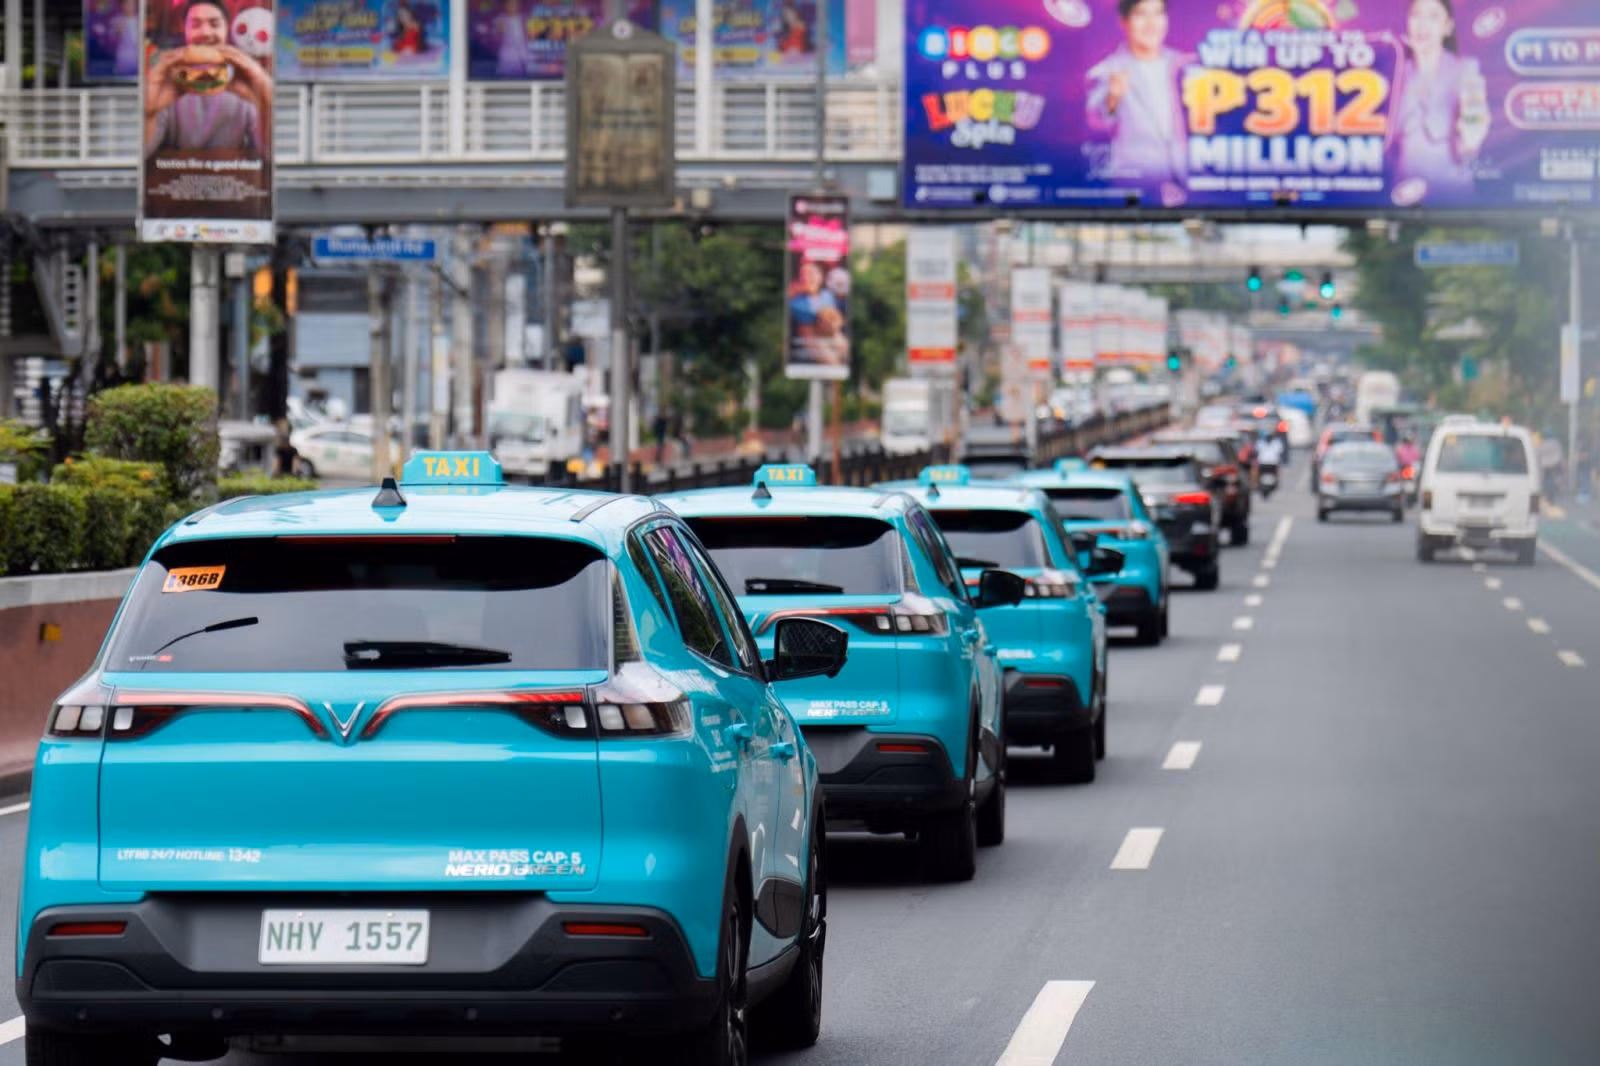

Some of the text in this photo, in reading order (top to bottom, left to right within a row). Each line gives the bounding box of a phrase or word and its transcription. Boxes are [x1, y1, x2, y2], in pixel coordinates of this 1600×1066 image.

[1276, 45, 1323, 68] UP
[1329, 44, 1375, 68] TO
[1187, 135, 1386, 174] MILLION
[422, 456, 480, 477] TAXI
[767, 467, 804, 481] TAXI
[151, 849, 175, 860] 24/7
[176, 849, 225, 861] HOTLINE
[229, 848, 261, 863] 1342
[448, 849, 486, 863] MAX
[489, 849, 529, 863] PASS
[571, 851, 582, 865] 5
[445, 863, 586, 876] NERIO GREEN
[266, 921, 423, 951] NHY 1557
